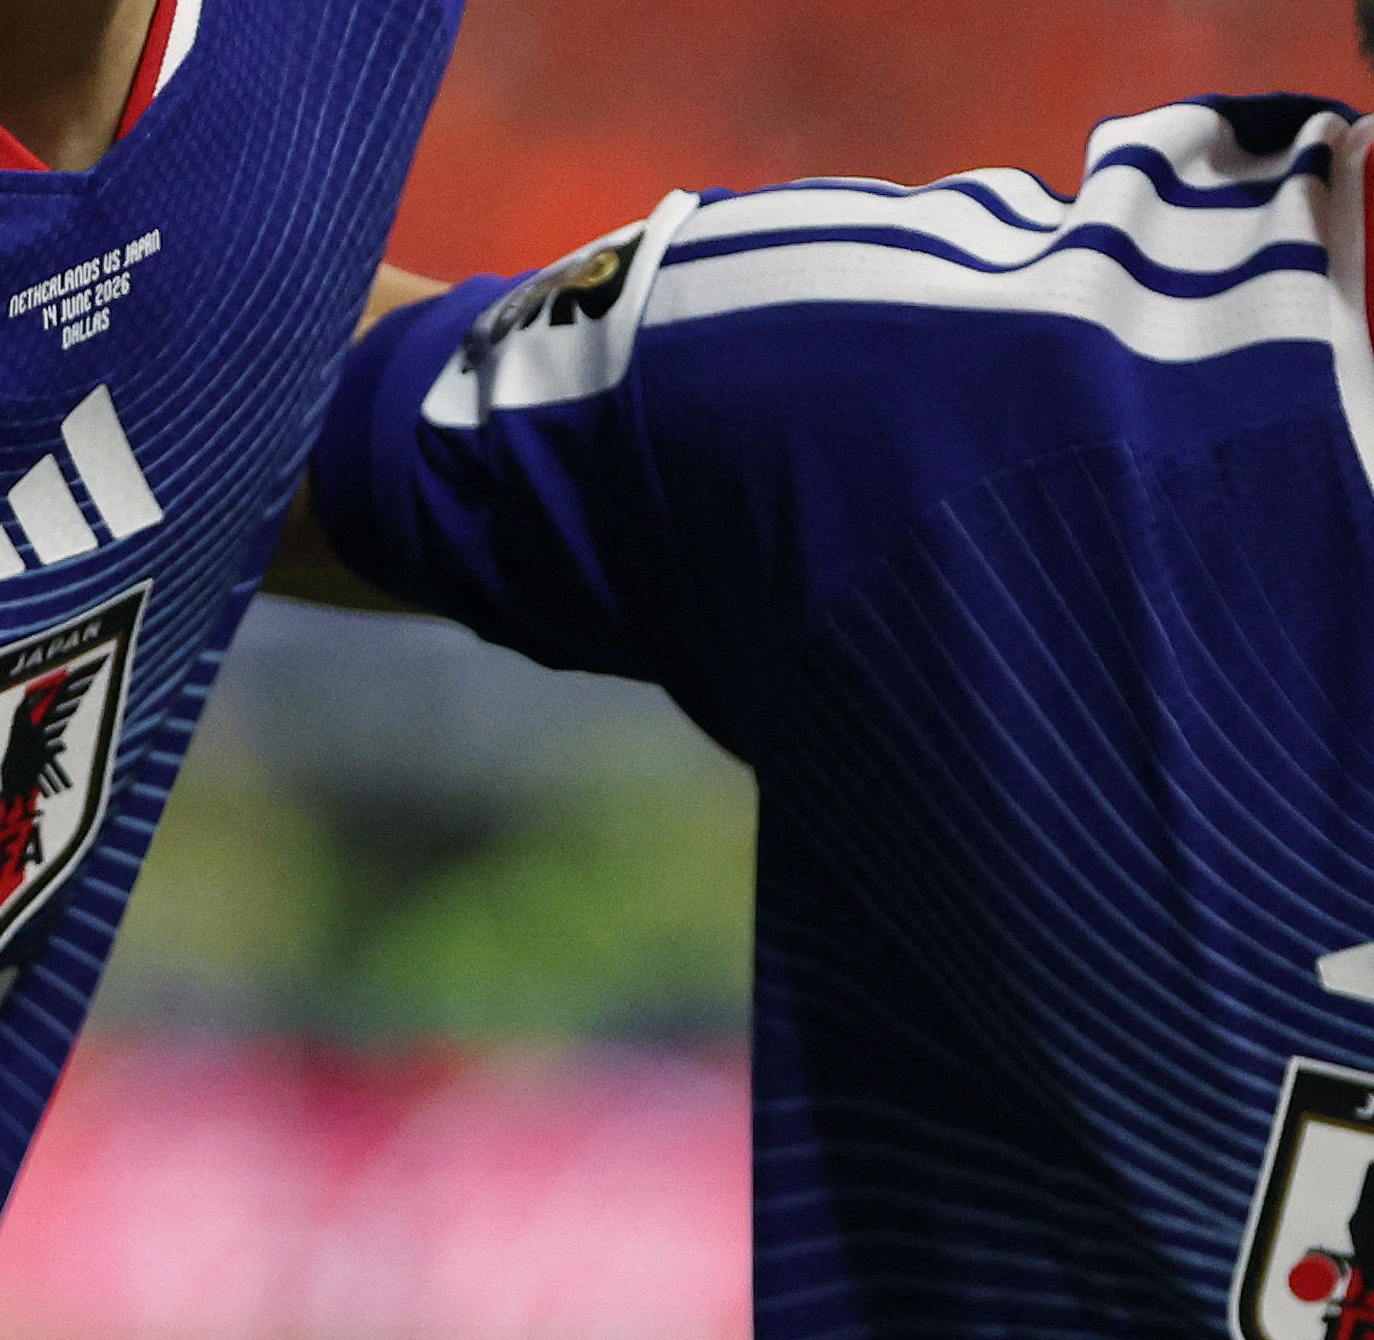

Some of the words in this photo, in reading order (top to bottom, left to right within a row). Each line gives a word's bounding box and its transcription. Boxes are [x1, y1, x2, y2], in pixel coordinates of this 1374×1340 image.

[8, 257, 100, 318] NETHERLANDS
[123, 228, 161, 267] JAPAN
[42, 303, 57, 331] 14
[60, 288, 92, 323] JUNE
[94, 271, 130, 307] 2026
[61, 306, 110, 351] DALLAS
[10, 621, 101, 677] JAPAN
